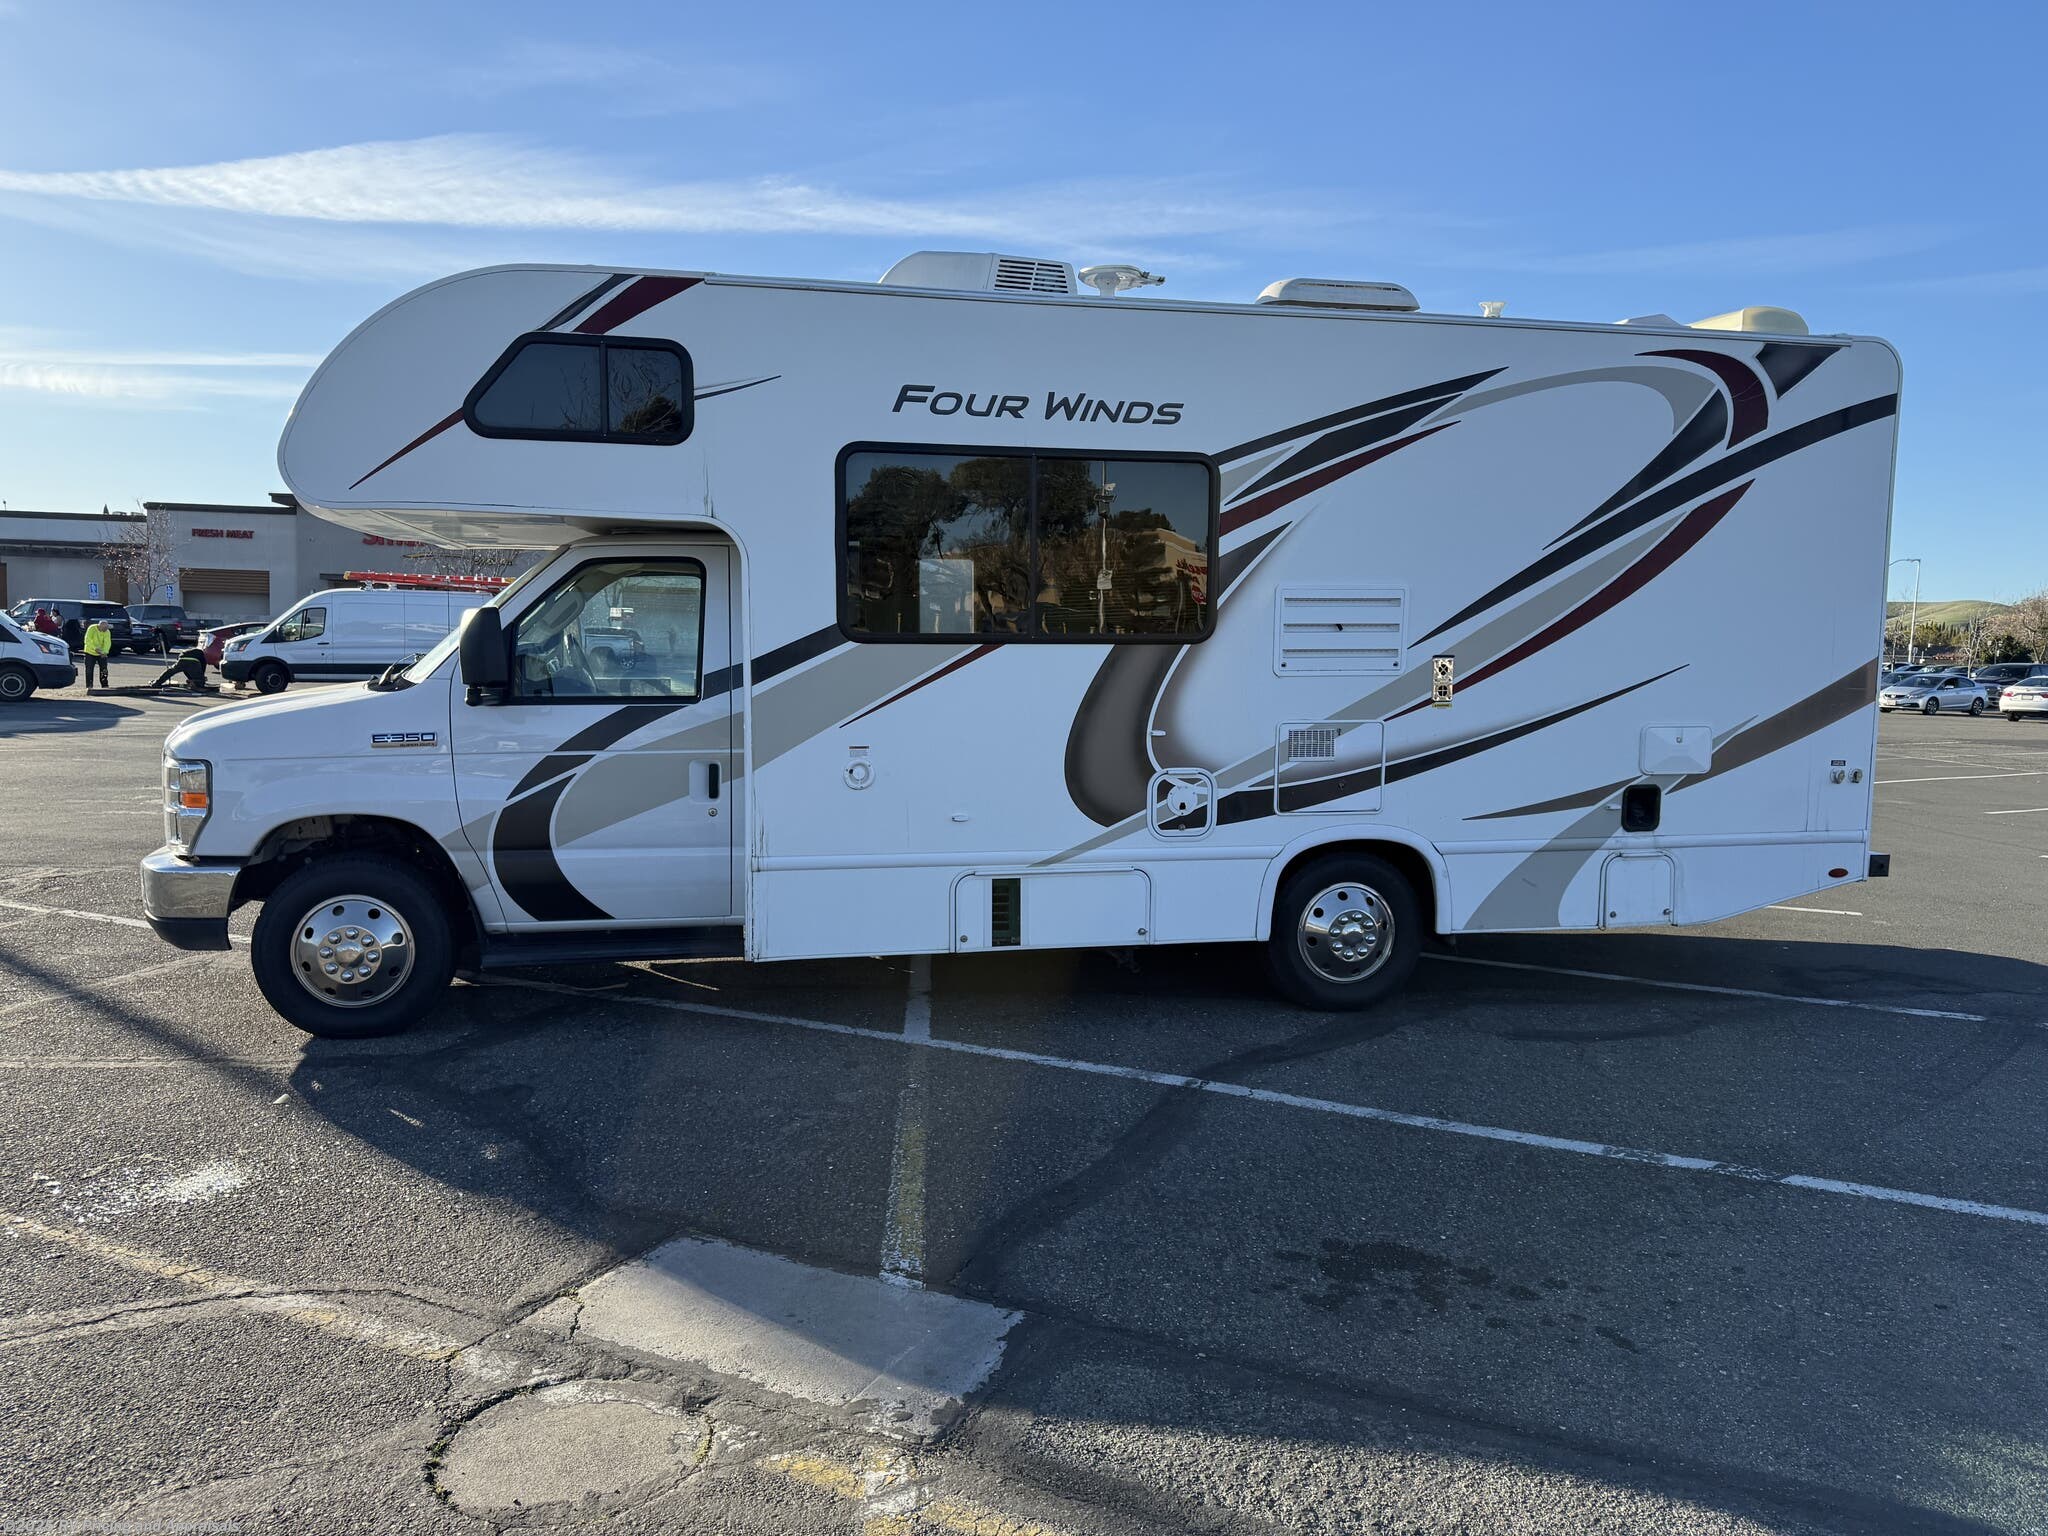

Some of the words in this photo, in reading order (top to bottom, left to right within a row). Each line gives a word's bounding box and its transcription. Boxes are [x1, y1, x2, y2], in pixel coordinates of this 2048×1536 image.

[892, 384, 1030, 419] FOUR
[1044, 391, 1185, 425] WINDS
[192, 528, 224, 538] FRESH
[226, 529, 255, 539] MEAT
